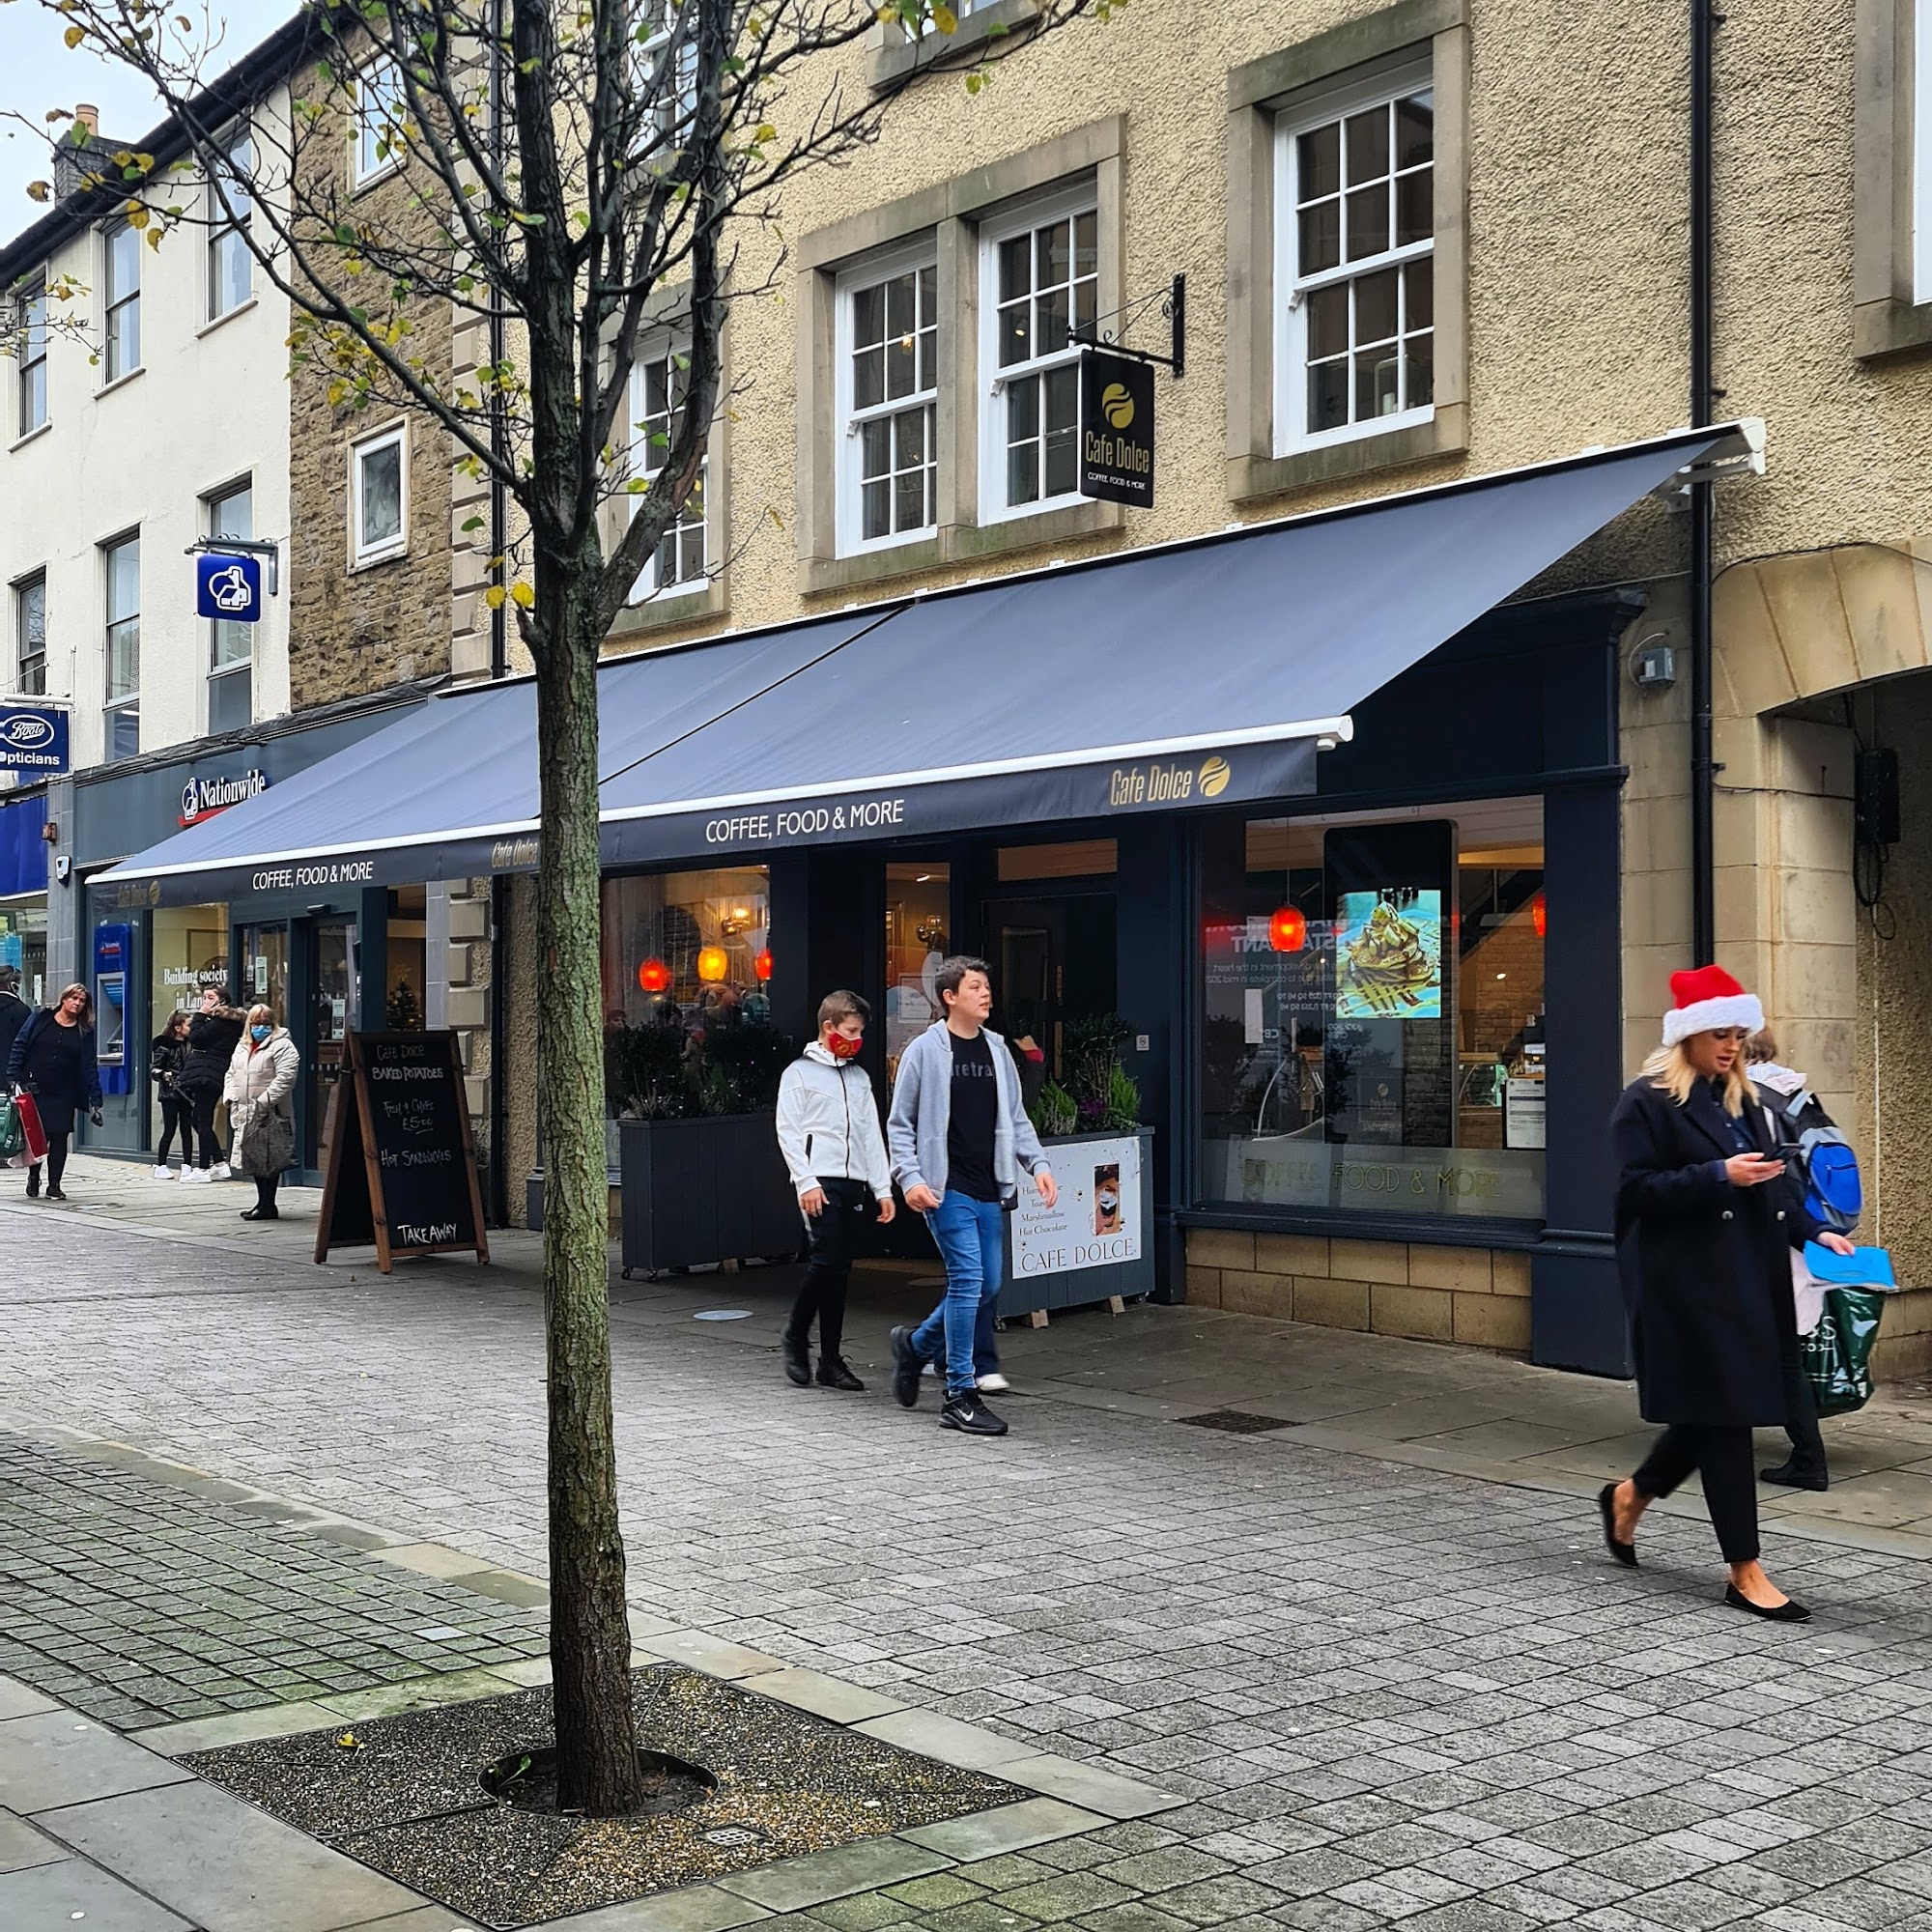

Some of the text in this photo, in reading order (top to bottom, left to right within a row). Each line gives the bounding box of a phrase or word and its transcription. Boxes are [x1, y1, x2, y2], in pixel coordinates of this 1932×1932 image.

[1085, 430, 1150, 473] Cafe Dolce
[1109, 475, 1125, 487] FOOD
[1130, 480, 1146, 491] MORE
[8, 721, 45, 741] Boots
[199, 768, 266, 810] Nationwide
[1110, 763, 1193, 807] Cafe Dolce
[705, 799, 904, 843] COFFEE, FOOD & MORE
[252, 861, 374, 890] COFFEE, FOOD & MORE
[163, 966, 199, 989] Building
[199, 964, 228, 986] society
[176, 991, 185, 1009] in
[371, 1065, 444, 1082] BAKED POTATOES
[1333, 1163, 1401, 1193] FOOD
[1410, 1168, 1426, 1194] &
[1436, 1167, 1503, 1199] MORE
[1019, 1223, 1068, 1236] Hot Chocolate
[1021, 1237, 1133, 1272] CAFE DOLCE
